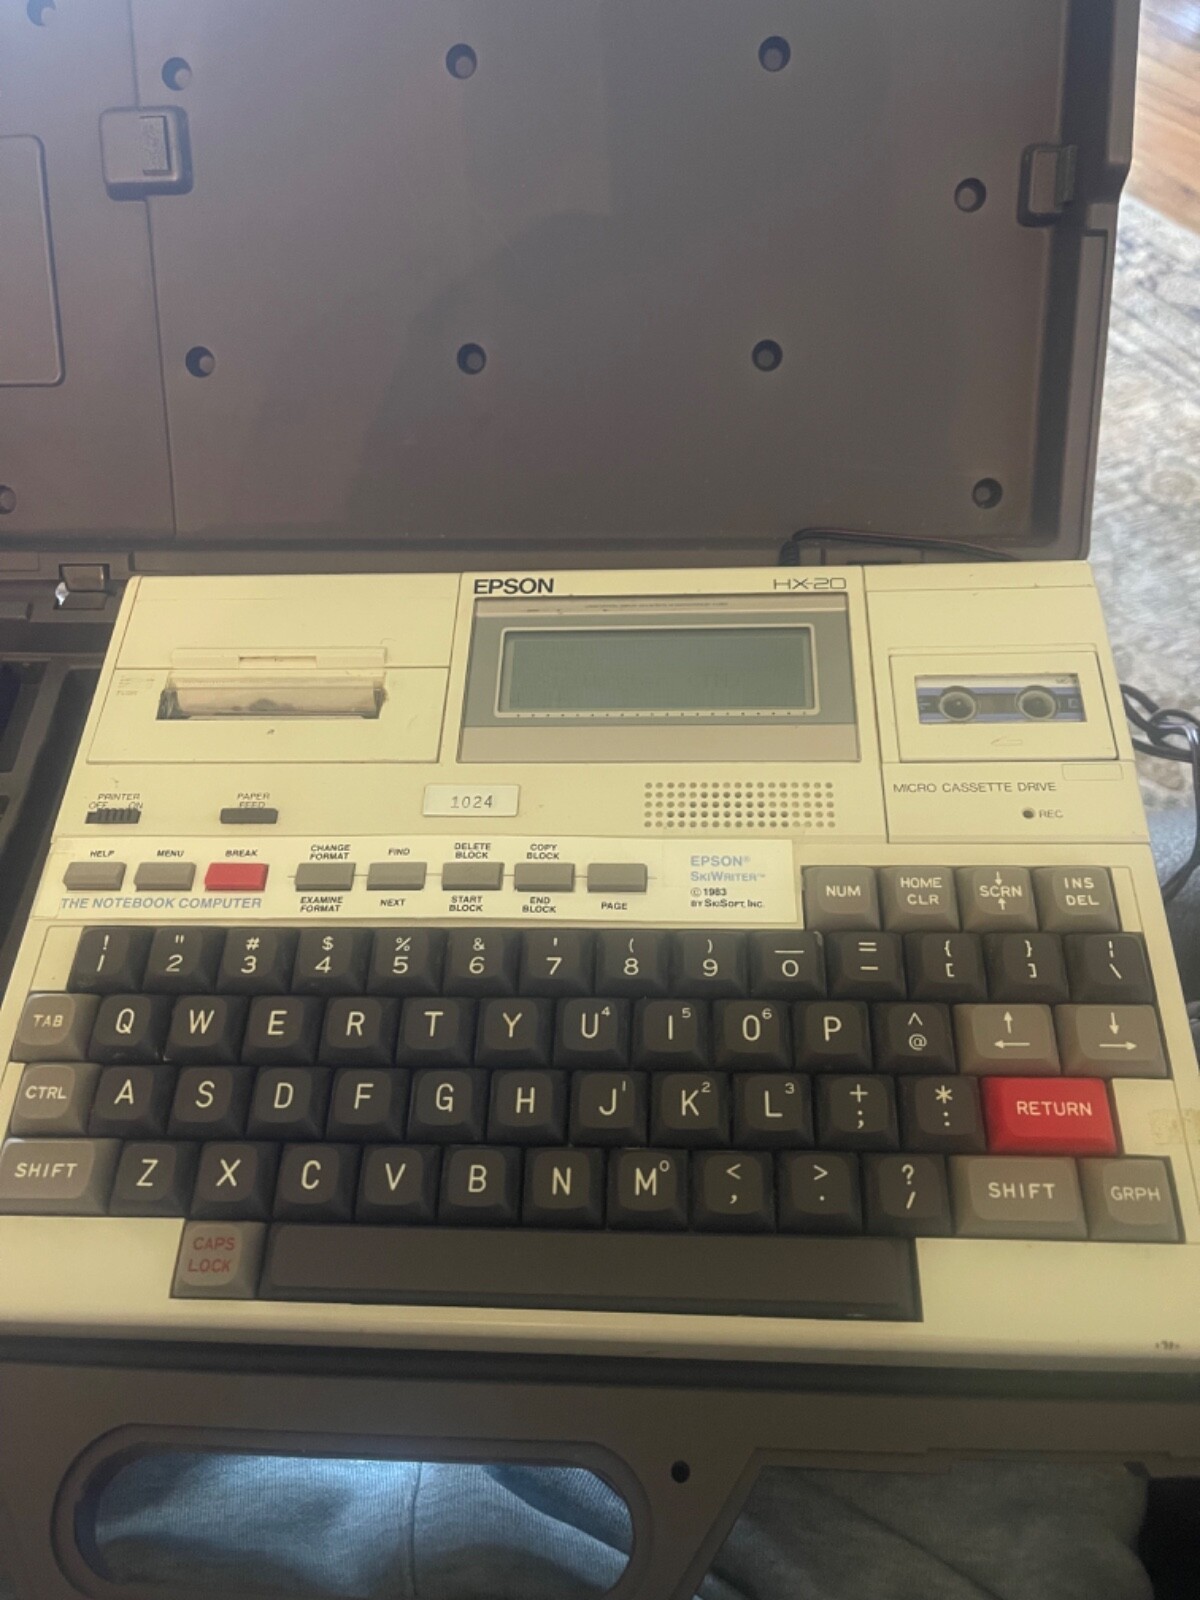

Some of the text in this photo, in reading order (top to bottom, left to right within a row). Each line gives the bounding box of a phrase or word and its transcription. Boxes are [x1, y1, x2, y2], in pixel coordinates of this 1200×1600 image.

[474, 578, 554, 594] EPSON
[773, 577, 847, 590] HX-20
[893, 781, 1057, 793] MICRO CASSETTE DRIVE
[98, 793, 141, 801] PRINTER
[236, 792, 270, 801] PAPER
[450, 795, 494, 809] 1024
[88, 801, 143, 809] OFF ON
[239, 801, 266, 809] FEED
[1039, 809, 1064, 819] REC
[225, 849, 258, 858] BREAK
[311, 844, 351, 852] CHANGE
[388, 847, 410, 856] FIND
[454, 842, 491, 851] DELETE
[530, 843, 557, 852] COPY
[90, 850, 115, 858] HELP
[157, 850, 185, 858] MENU
[309, 852, 349, 860] FORMAT
[455, 851, 488, 860] BLOCK
[526, 852, 560, 860] BLOCK
[900, 877, 943, 889] HOME
[1064, 877, 1095, 889] INS
[703, 887, 728, 896] 1983
[826, 885, 861, 898] NUM
[979, 885, 1023, 898] SCRN
[61, 897, 262, 909] THE NOTEBOOK COMPUTER
[300, 896, 343, 905] EXAMINE
[380, 898, 406, 907] NEXT
[451, 895, 483, 904] START
[529, 896, 551, 905] END
[601, 902, 628, 910] PAGE
[907, 894, 940, 906] CLR
[1065, 894, 1100, 906] DEL
[300, 904, 341, 913] FORMAT
[449, 904, 483, 912] BLOCK
[522, 905, 556, 913] BLOCK
[165, 953, 184, 972] 2
[240, 955, 257, 974] 3
[314, 955, 331, 974] 4
[392, 956, 409, 974] 5
[468, 956, 485, 974] 6
[546, 956, 563, 976] 7
[623, 957, 639, 976] 8
[702, 958, 719, 977] 9
[33, 1013, 64, 1028] TAB
[115, 1007, 135, 1034] Q
[189, 1009, 215, 1034] W
[267, 1010, 288, 1036] E
[346, 1011, 366, 1036] R
[424, 1010, 444, 1037] T
[502, 1012, 523, 1038] Y
[823, 1015, 842, 1042] P
[24, 1085, 67, 1100] CTRL
[113, 1079, 134, 1105] A
[195, 1080, 215, 1108] S
[273, 1082, 294, 1109] D
[353, 1083, 374, 1110] F
[435, 1083, 454, 1112] G
[515, 1086, 535, 1114] H
[1016, 1100, 1093, 1117] RETURN
[14, 1162, 78, 1178] SHIFT
[136, 1158, 159, 1187] Z
[216, 1159, 241, 1187] X
[301, 1159, 322, 1190] C
[385, 1163, 406, 1191] V
[468, 1164, 487, 1193] B
[552, 1167, 572, 1196] N
[988, 1181, 1055, 1199] SHIFT
[1110, 1185, 1161, 1202] GRPH
[193, 1236, 236, 1251] CAPS
[188, 1259, 231, 1273] LOCK
